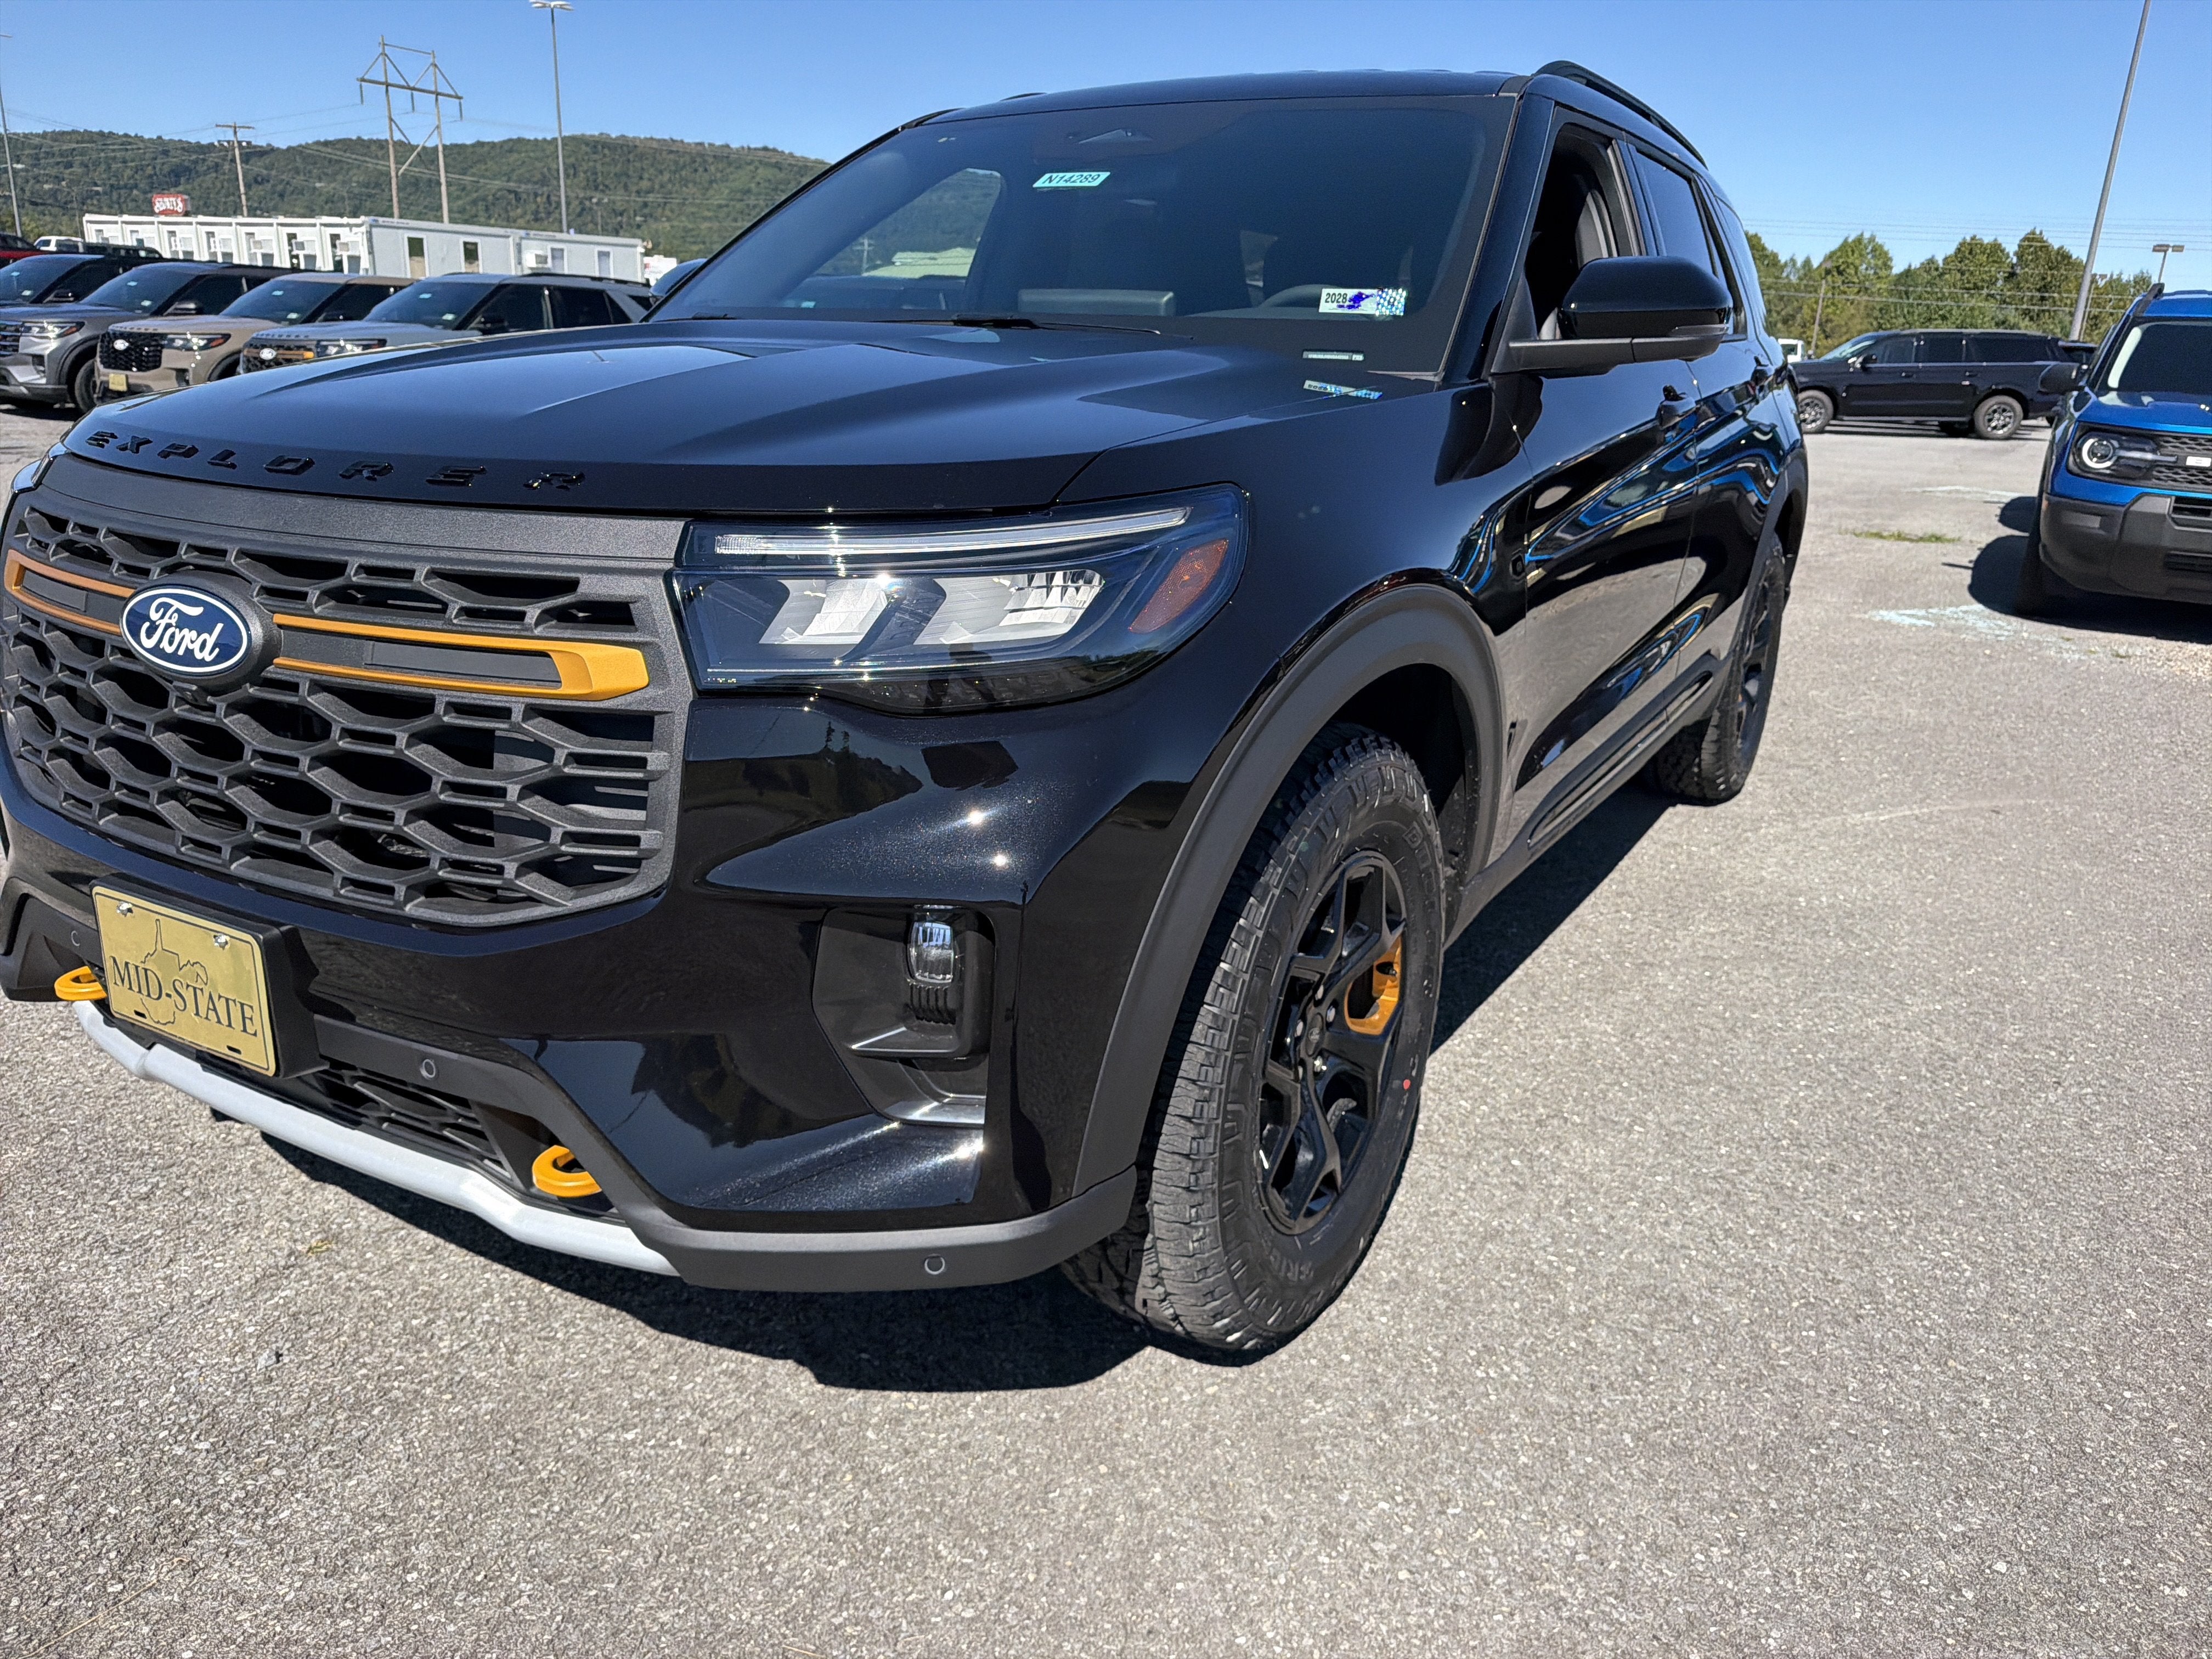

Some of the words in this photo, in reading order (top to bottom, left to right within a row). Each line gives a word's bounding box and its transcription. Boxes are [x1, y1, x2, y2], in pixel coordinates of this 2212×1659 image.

[1042, 173, 1101, 184] N14289
[1324, 292, 1348, 304] 2028
[85, 431, 586, 490] EXPLORER
[140, 597, 224, 662] Ford
[110, 955, 257, 1037] MID-STATE
